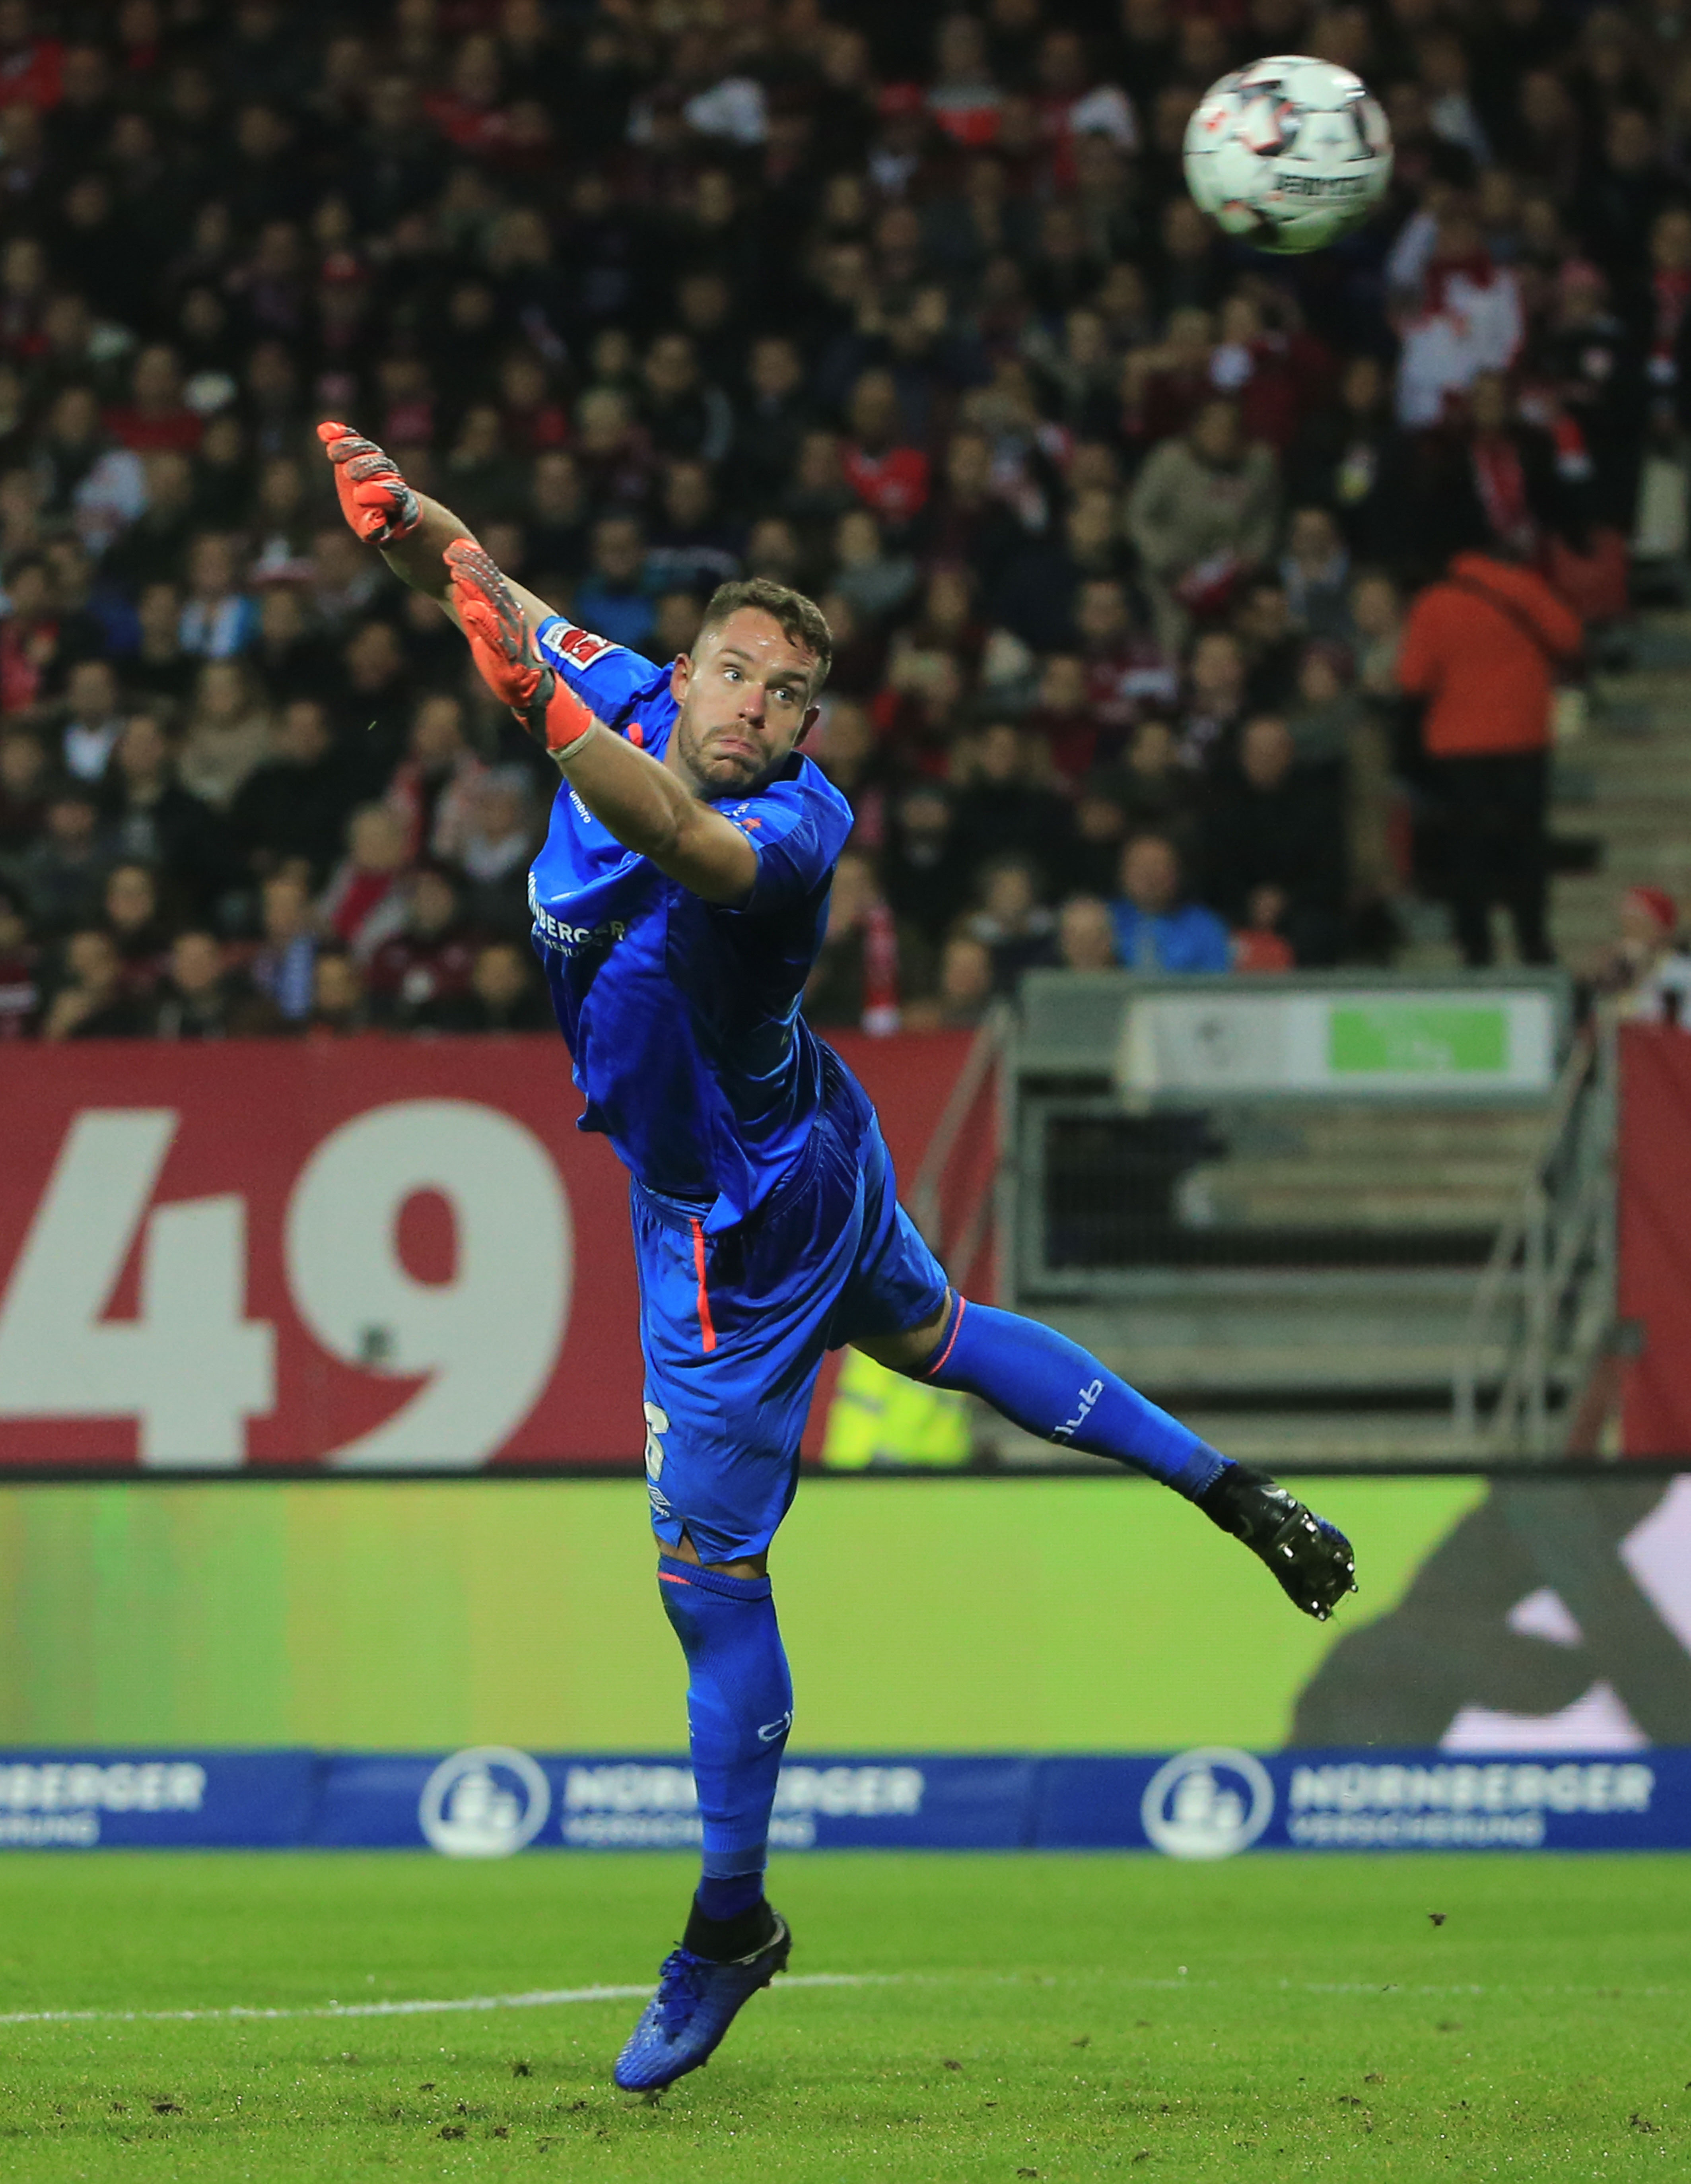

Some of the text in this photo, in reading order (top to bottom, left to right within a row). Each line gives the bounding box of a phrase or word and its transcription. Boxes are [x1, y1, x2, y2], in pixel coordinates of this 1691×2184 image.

[569, 790, 591, 824] umbro
[1049, 1379, 1105, 1445] lub
[0, 1762, 207, 1812] BERGER
